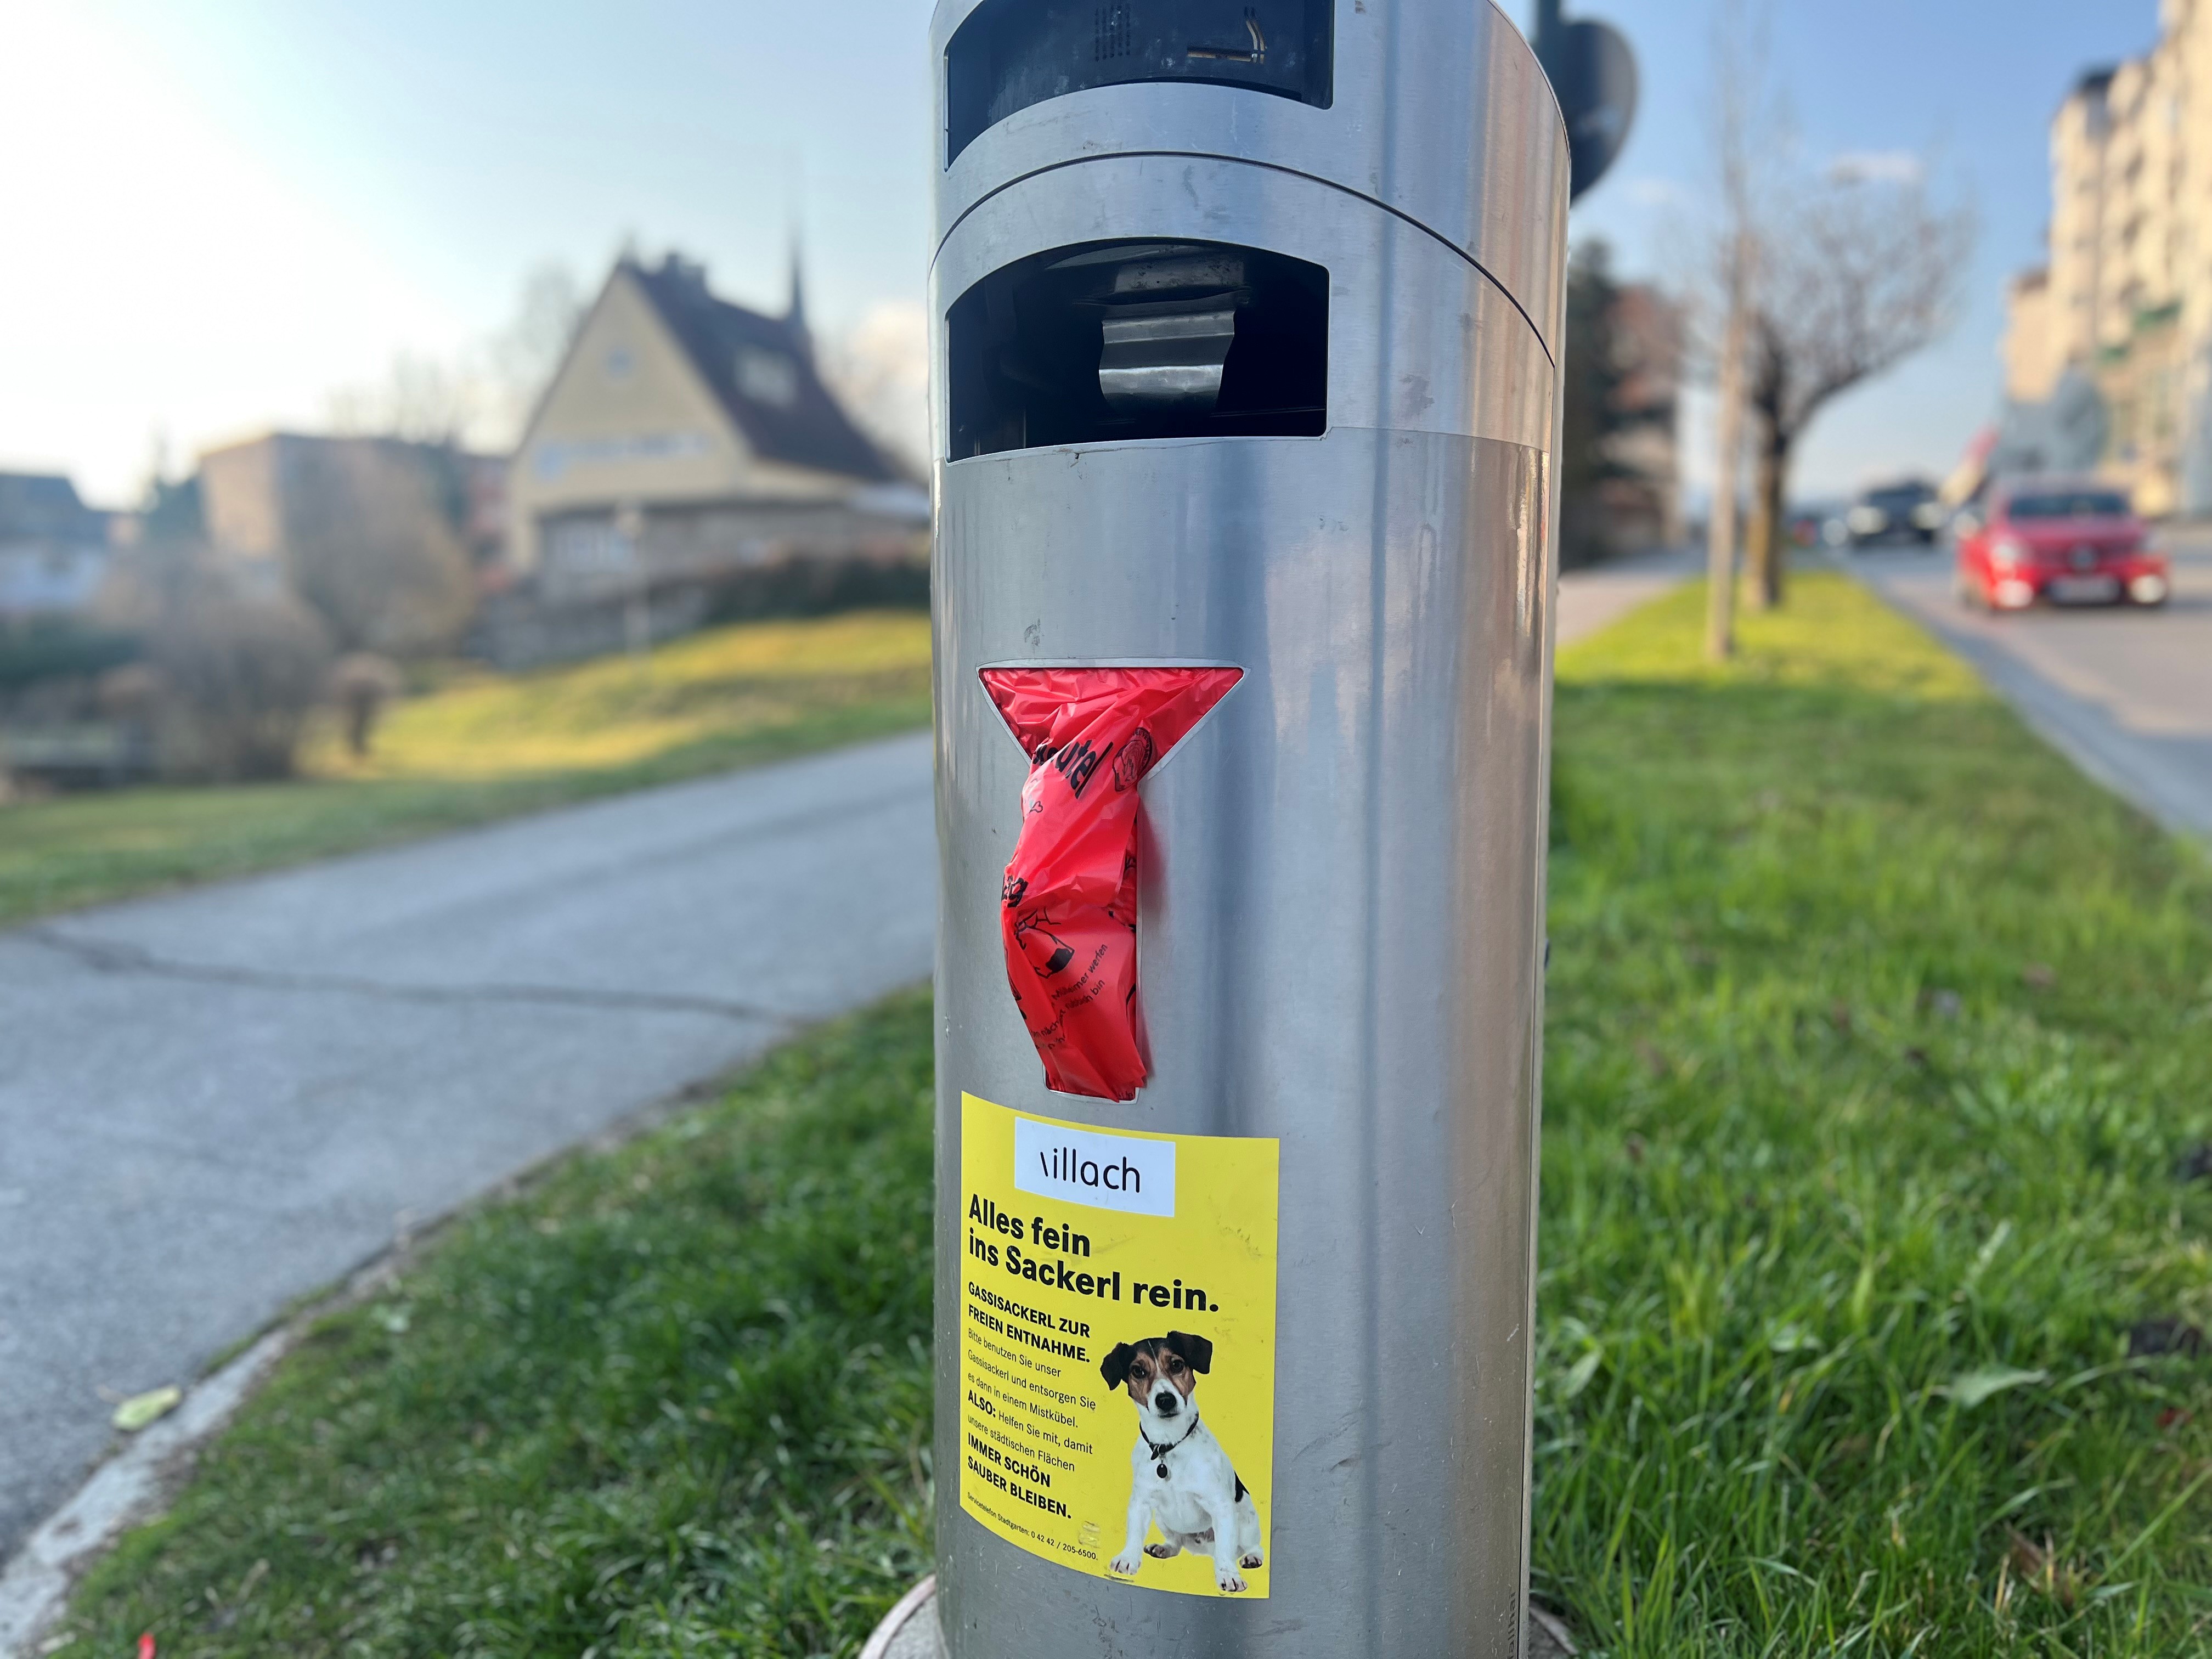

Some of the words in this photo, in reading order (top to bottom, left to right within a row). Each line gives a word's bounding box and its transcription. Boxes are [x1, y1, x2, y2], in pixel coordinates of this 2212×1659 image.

[1087, 944, 1108, 973] werfen
[1090, 979, 1105, 996] bin
[969, 1193, 1024, 1239] Alles
[1031, 1217, 1090, 1256] fein
[969, 1228, 998, 1266] ins
[1005, 1246, 1120, 1300] Sackerl
[1133, 1279, 1219, 1312] rein.
[968, 1282, 1055, 1329] GASSISACKERL
[1059, 1318, 1090, 1338] ZUR
[969, 1304, 1003, 1334] FREIEN
[1007, 1323, 1090, 1362] ENTNAHME.
[968, 1328, 981, 1345] Bitte
[984, 1336, 1016, 1362] benutzen
[1019, 1355, 1032, 1368] Sie
[1035, 1362, 1061, 1378] unser
[968, 1349, 1009, 1380] Gassisackerl
[1012, 1374, 1026, 1389] und
[1029, 1383, 1076, 1405] entsorgen
[1080, 1396, 1096, 1409] Sie
[968, 1373, 975, 1383] es
[977, 1376, 992, 1394] dann
[994, 1386, 1000, 1398] in
[1003, 1392, 1026, 1410] einem
[1030, 1402, 1078, 1428] Mistkübel.
[968, 1389, 996, 1418] ALSO:
[998, 1412, 1024, 1431] Helfen
[1027, 1424, 1040, 1437] Sie
[1043, 1432, 1060, 1447] mit,
[1064, 1438, 1093, 1454] damit
[968, 1415, 988, 1435] unsere
[990, 1430, 1035, 1458] städtischen
[1039, 1450, 1075, 1472] Flächen
[968, 1432, 1001, 1466] IMMER
[1005, 1456, 1050, 1488] SCHÖN
[968, 1455, 1007, 1492] SAUBER
[1011, 1482, 1071, 1519] BLEIBEN.
[967, 1492, 997, 1519] Servicetelefon
[998, 1513, 1030, 1536] Stadtgarten:
[1037, 1534, 1045, 1543] 42
[1046, 1538, 1054, 1546] 42
[1063, 1543, 1098, 1561] 205-6500.
